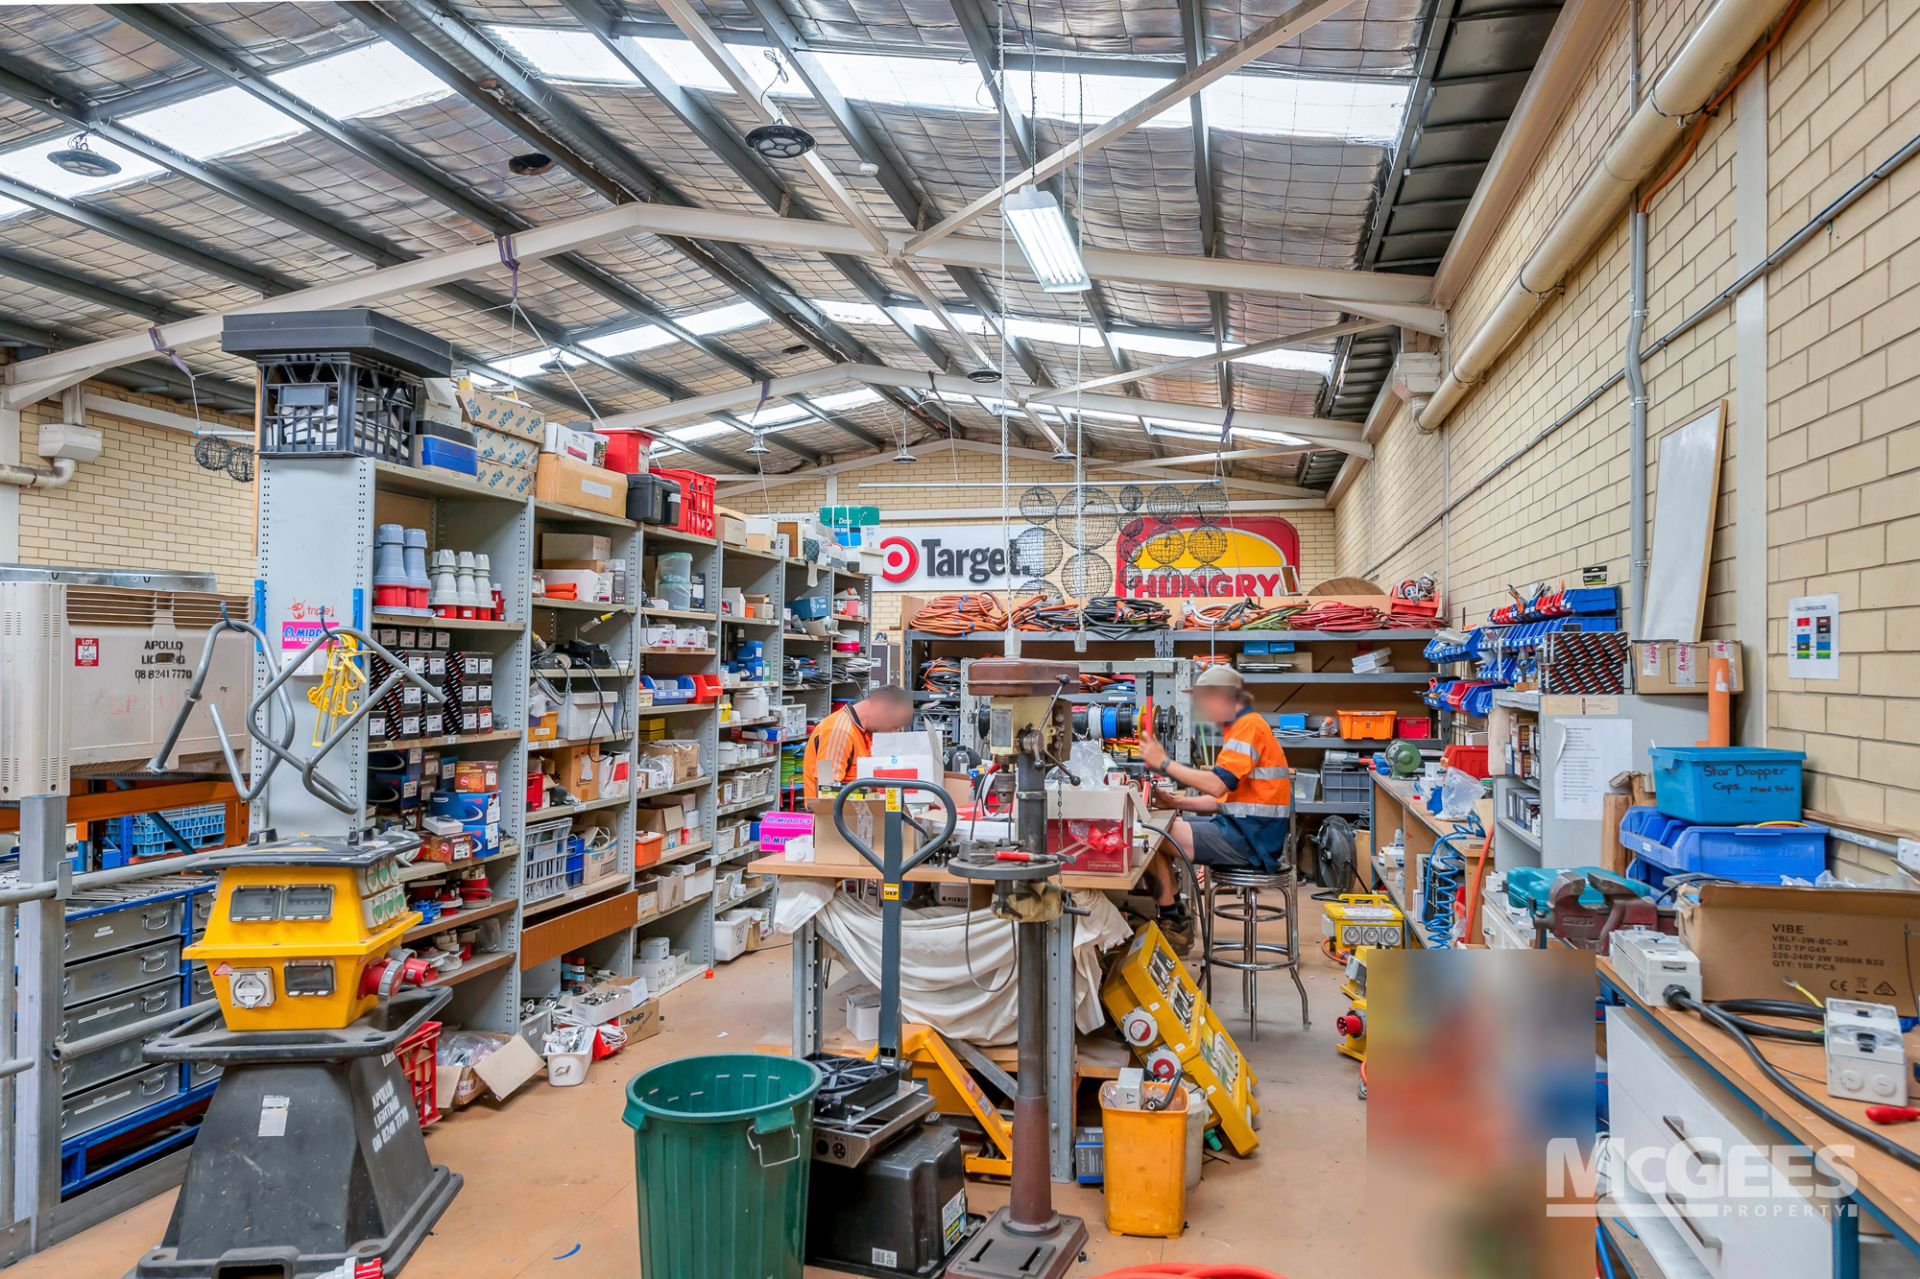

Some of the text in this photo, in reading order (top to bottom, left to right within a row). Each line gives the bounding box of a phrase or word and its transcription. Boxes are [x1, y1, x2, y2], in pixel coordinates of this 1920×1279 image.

[1133, 573, 1281, 597] HUNGRY
[144, 640, 184, 651] APOLLO
[134, 669, 192, 680] 08 8241 7770
[1735, 764, 1788, 781] Dropper
[1772, 923, 1805, 934] VIBE
[1816, 963, 1836, 971] PCS
[1866, 958, 1885, 966] B22
